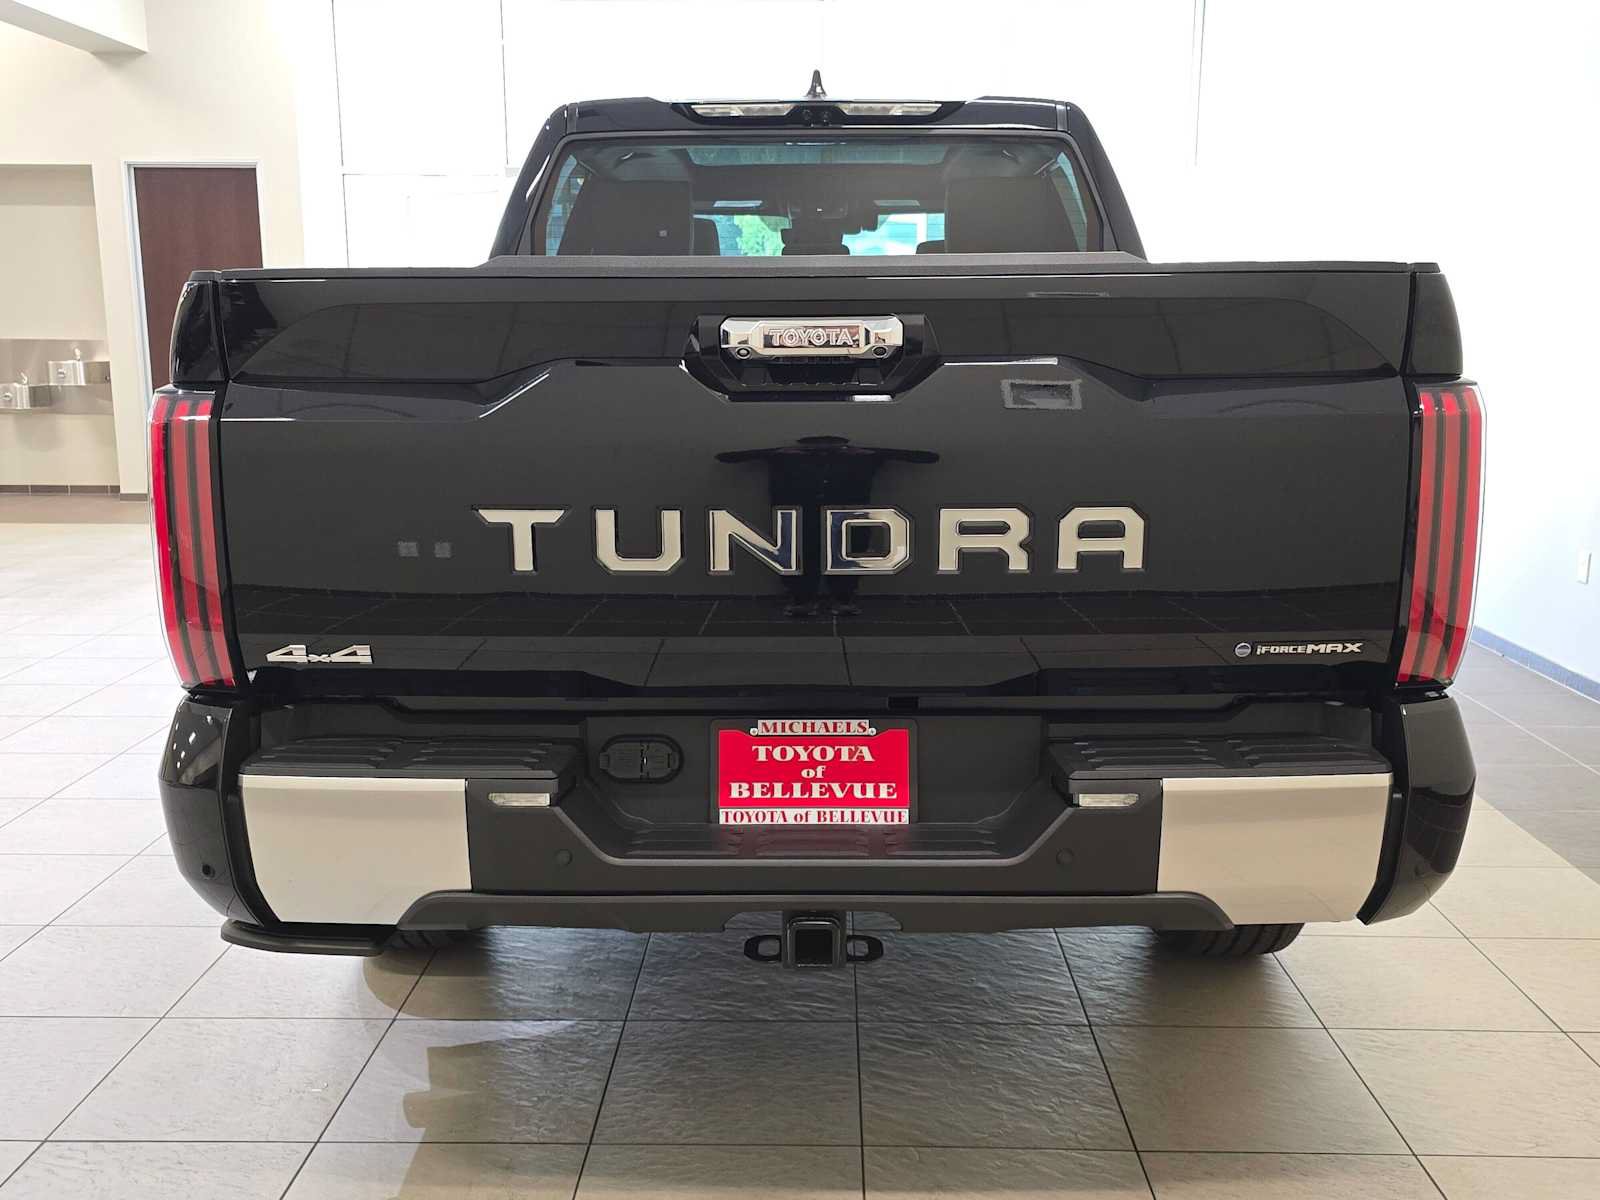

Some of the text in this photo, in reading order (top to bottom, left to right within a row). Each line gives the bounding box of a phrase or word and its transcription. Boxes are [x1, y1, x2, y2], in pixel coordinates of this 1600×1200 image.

[767, 327, 854, 347] TOYOTA
[475, 506, 1147, 575] TUNDRA
[759, 720, 869, 734] MICHAELS
[751, 745, 875, 762] TOYOTA
[801, 765, 826, 779] of
[729, 782, 897, 799] BELLEVUE
[722, 810, 906, 823] TOYOTA of BELLEVUE
